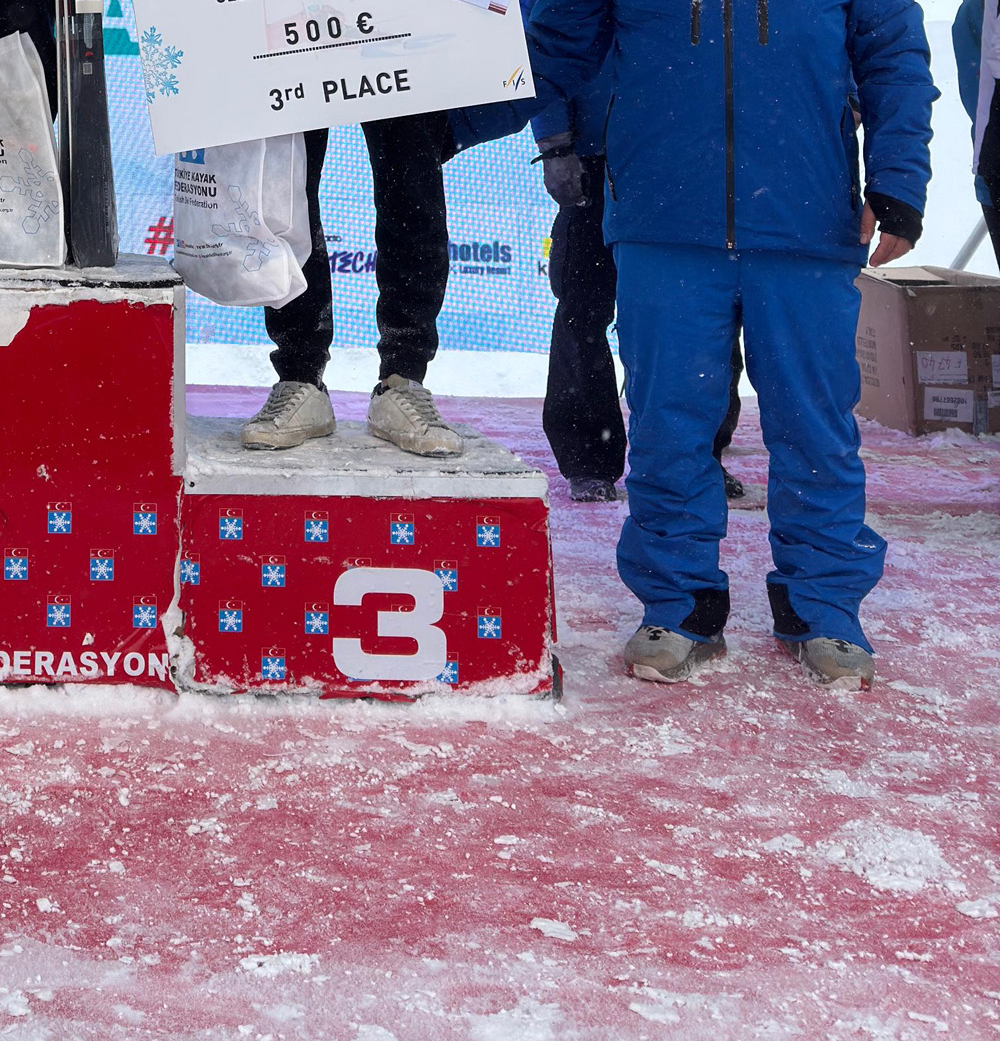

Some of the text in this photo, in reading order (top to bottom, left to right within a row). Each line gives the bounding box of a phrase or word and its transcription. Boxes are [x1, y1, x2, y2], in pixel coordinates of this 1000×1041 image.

[284, 11, 374, 46] 500 €
[269, 69, 411, 111] 3rd PLACE
[191, 171, 217, 184] KAYAK
[332, 567, 448, 682] 3
